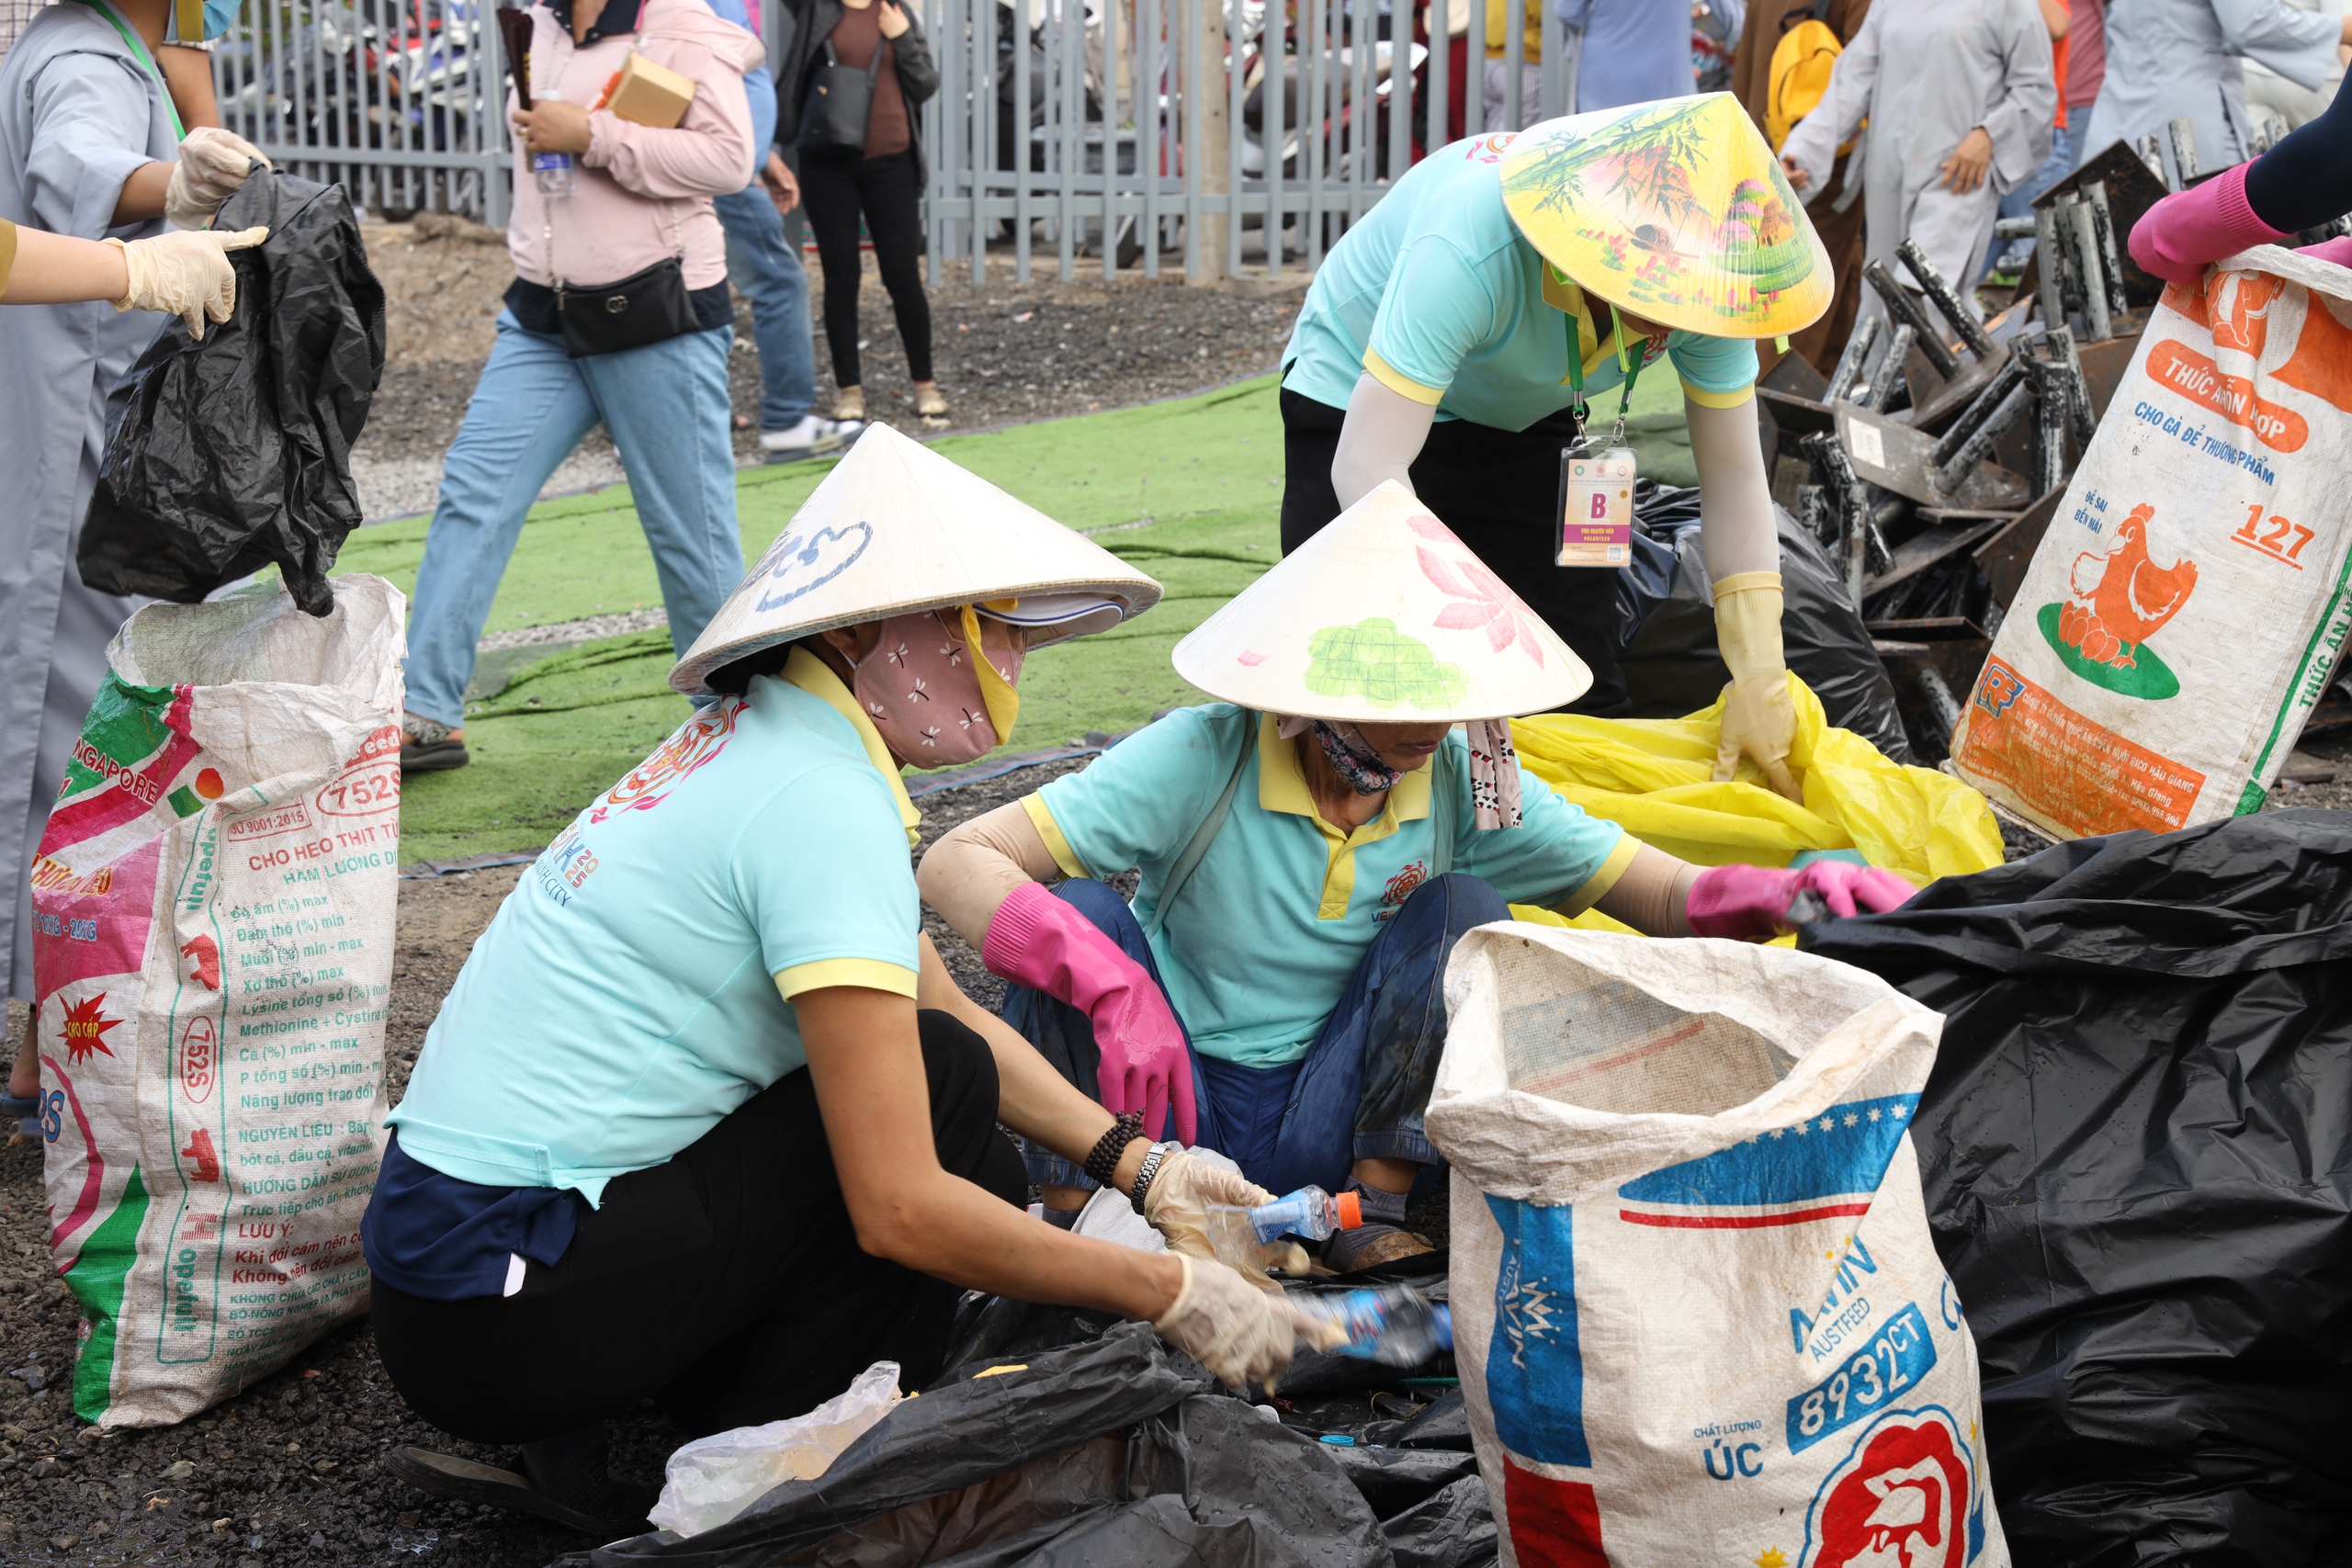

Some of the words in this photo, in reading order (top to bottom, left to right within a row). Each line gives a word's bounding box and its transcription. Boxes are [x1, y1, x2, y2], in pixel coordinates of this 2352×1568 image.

[2164, 355, 2213, 397] THỨC
[2134, 401, 2165, 426] CHO
[2162, 414, 2184, 437] GÀ
[2180, 423, 2207, 448] ĐẺ
[2235, 450, 2276, 486] PHẨM
[1590, 493, 1607, 519] B
[2086, 490, 2097, 506] ĐẺ
[2095, 496, 2109, 513] SAI
[2086, 515, 2103, 535] MÁI
[2236, 503, 2315, 559] 127
[2298, 654, 2334, 708] THỨC
[2324, 619, 2350, 653] ĂN
[2130, 756, 2149, 773] RICO
[2149, 763, 2166, 781] HẬU
[2167, 774, 2195, 794] GIANG
[2147, 786, 2173, 807] Giang
[247, 811, 305, 833] 9001:2015
[248, 849, 290, 872] CHO
[293, 837, 334, 862] HEO
[336, 827, 376, 848] THỊT
[282, 867, 321, 886] HÀM
[323, 852, 381, 879] LƯỢNG
[277, 897, 300, 914] (%)
[301, 896, 330, 908] max
[545, 878, 572, 908] CITY
[296, 918, 319, 936] (%)
[277, 945, 300, 965] (%)
[302, 941, 327, 957] min
[337, 938, 364, 952] max
[290, 968, 314, 988] (%)
[317, 966, 345, 980] max
[242, 999, 288, 1017] Lysine
[291, 990, 324, 1008] tổng
[327, 985, 346, 1001] số
[347, 984, 370, 1003] (%)
[372, 981, 388, 997] min
[66, 1021, 82, 1039] CAO
[82, 1016, 99, 1039] CẤP
[240, 1017, 319, 1037] Methionine
[322, 1018, 331, 1027] +
[334, 1009, 380, 1027] Cystine
[187, 1028, 210, 1089] 752S
[239, 1047, 259, 1062] Ca
[262, 1043, 286, 1062] (%)
[289, 1041, 316, 1055] min
[330, 1037, 358, 1051] max
[240, 1071, 250, 1085] P
[254, 1066, 288, 1084] tổng
[290, 1061, 310, 1078] số
[311, 1062, 336, 1080] (%)
[339, 1061, 363, 1075] min
[240, 1093, 279, 1111] Năng
[284, 1089, 324, 1107] lượng
[327, 1088, 353, 1102] trao
[356, 1080, 374, 1100] đổi
[238, 1122, 298, 1144] NGUYÊN
[301, 1119, 334, 1140] LIỆU
[240, 1153, 262, 1169] bột
[266, 1150, 286, 1166] cá,
[288, 1144, 313, 1163] dầu
[316, 1145, 334, 1160] cá,
[337, 1141, 373, 1157] vitamin
[242, 1177, 297, 1195] HƯỚNG
[300, 1168, 329, 1190] DẪN
[241, 1203, 274, 1218] Trực
[277, 1197, 302, 1217] tiếp
[304, 1197, 324, 1212] cho
[345, 1182, 377, 1200] không
[238, 1221, 275, 1239] LƯU
[281, 1218, 295, 1237] Ý:
[235, 1250, 265, 1265] Khi
[268, 1240, 289, 1264] đổi
[290, 1239, 321, 1258] cám
[323, 1235, 347, 1252] nên
[232, 1269, 288, 1286] Không
[289, 1263, 307, 1281] nên
[310, 1252, 333, 1273] đổi
[333, 1249, 359, 1266] cám
[230, 1291, 276, 1304] KHÔNG
[249, 1326, 276, 1338] TCCS
[1808, 1297, 1871, 1363] AUSTFEED
[1693, 1423, 1723, 1438] CHẤT
[1723, 1419, 1762, 1435] LƯỢNG
[1702, 1438, 1764, 1481] ÚC
